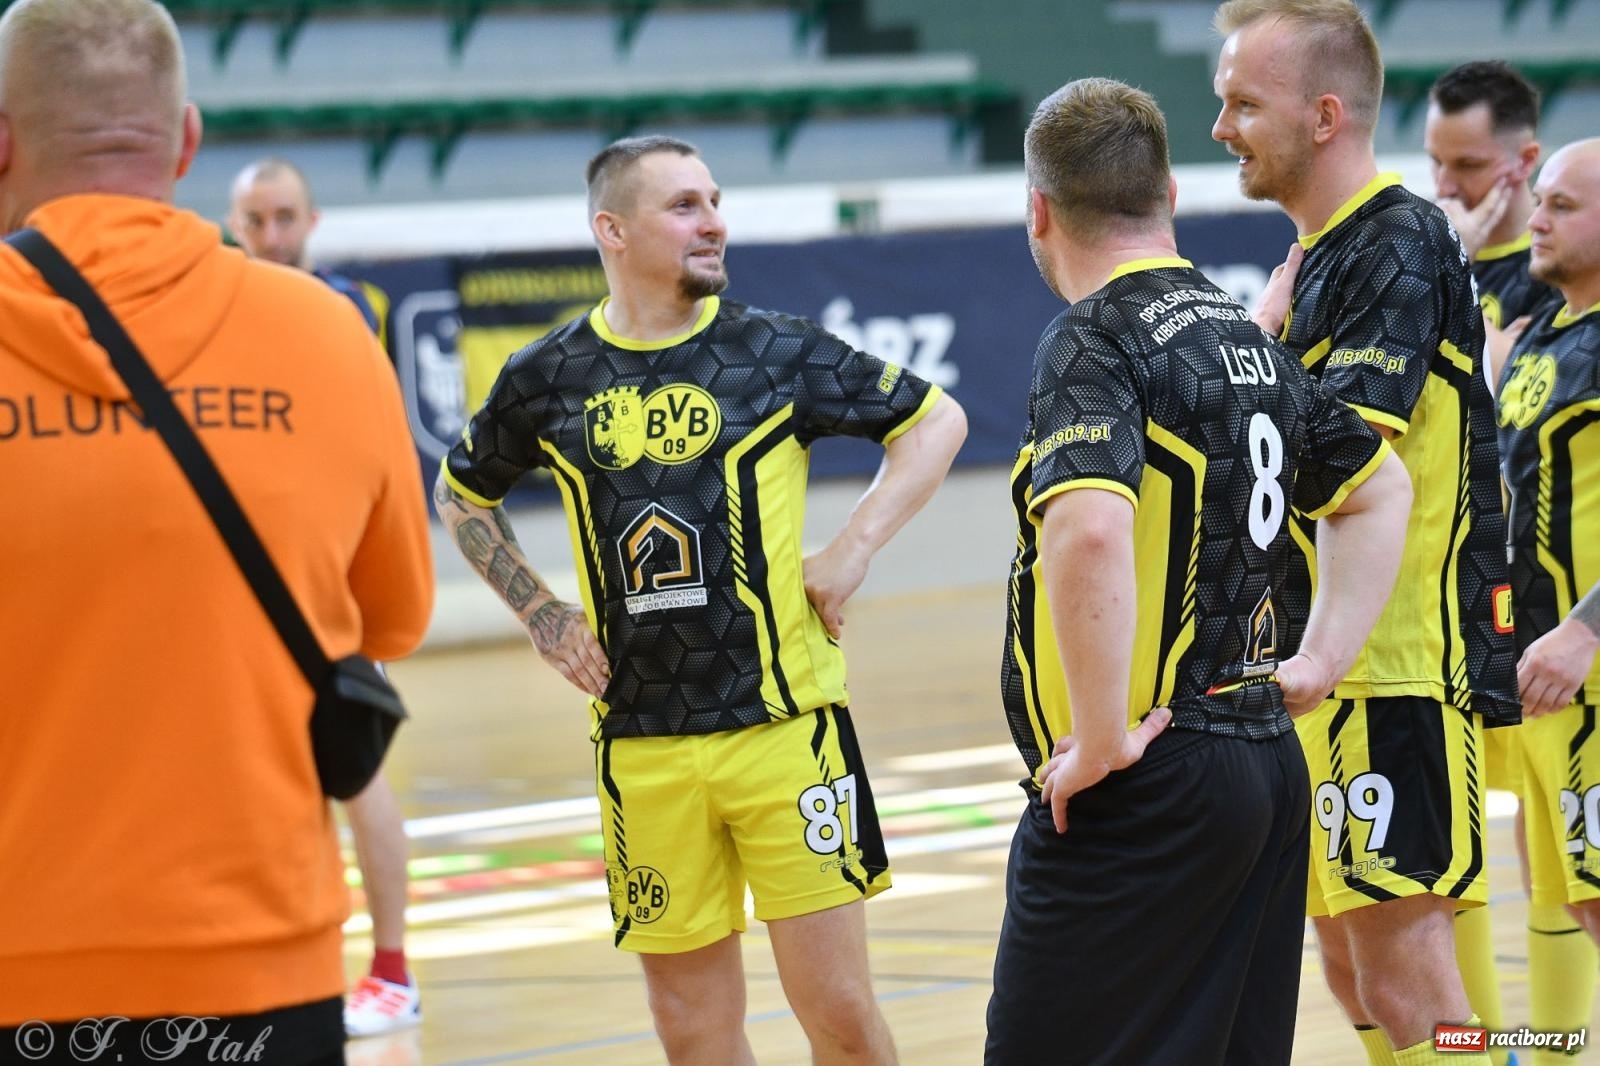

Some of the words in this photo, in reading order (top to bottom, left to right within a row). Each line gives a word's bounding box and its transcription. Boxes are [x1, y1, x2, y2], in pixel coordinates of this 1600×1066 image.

[1138, 289, 1195, 324] OPOLSKIE
[1151, 309, 1198, 346] KIBICÓW
[1219, 345, 1277, 386] LISU
[646, 393, 710, 440] BVB
[663, 438, 687, 456] 09
[1248, 412, 1285, 552] 8
[798, 773, 859, 855] 87
[1315, 772, 1394, 862] 99
[628, 871, 664, 909] BVB
[636, 905, 650, 919] 09
